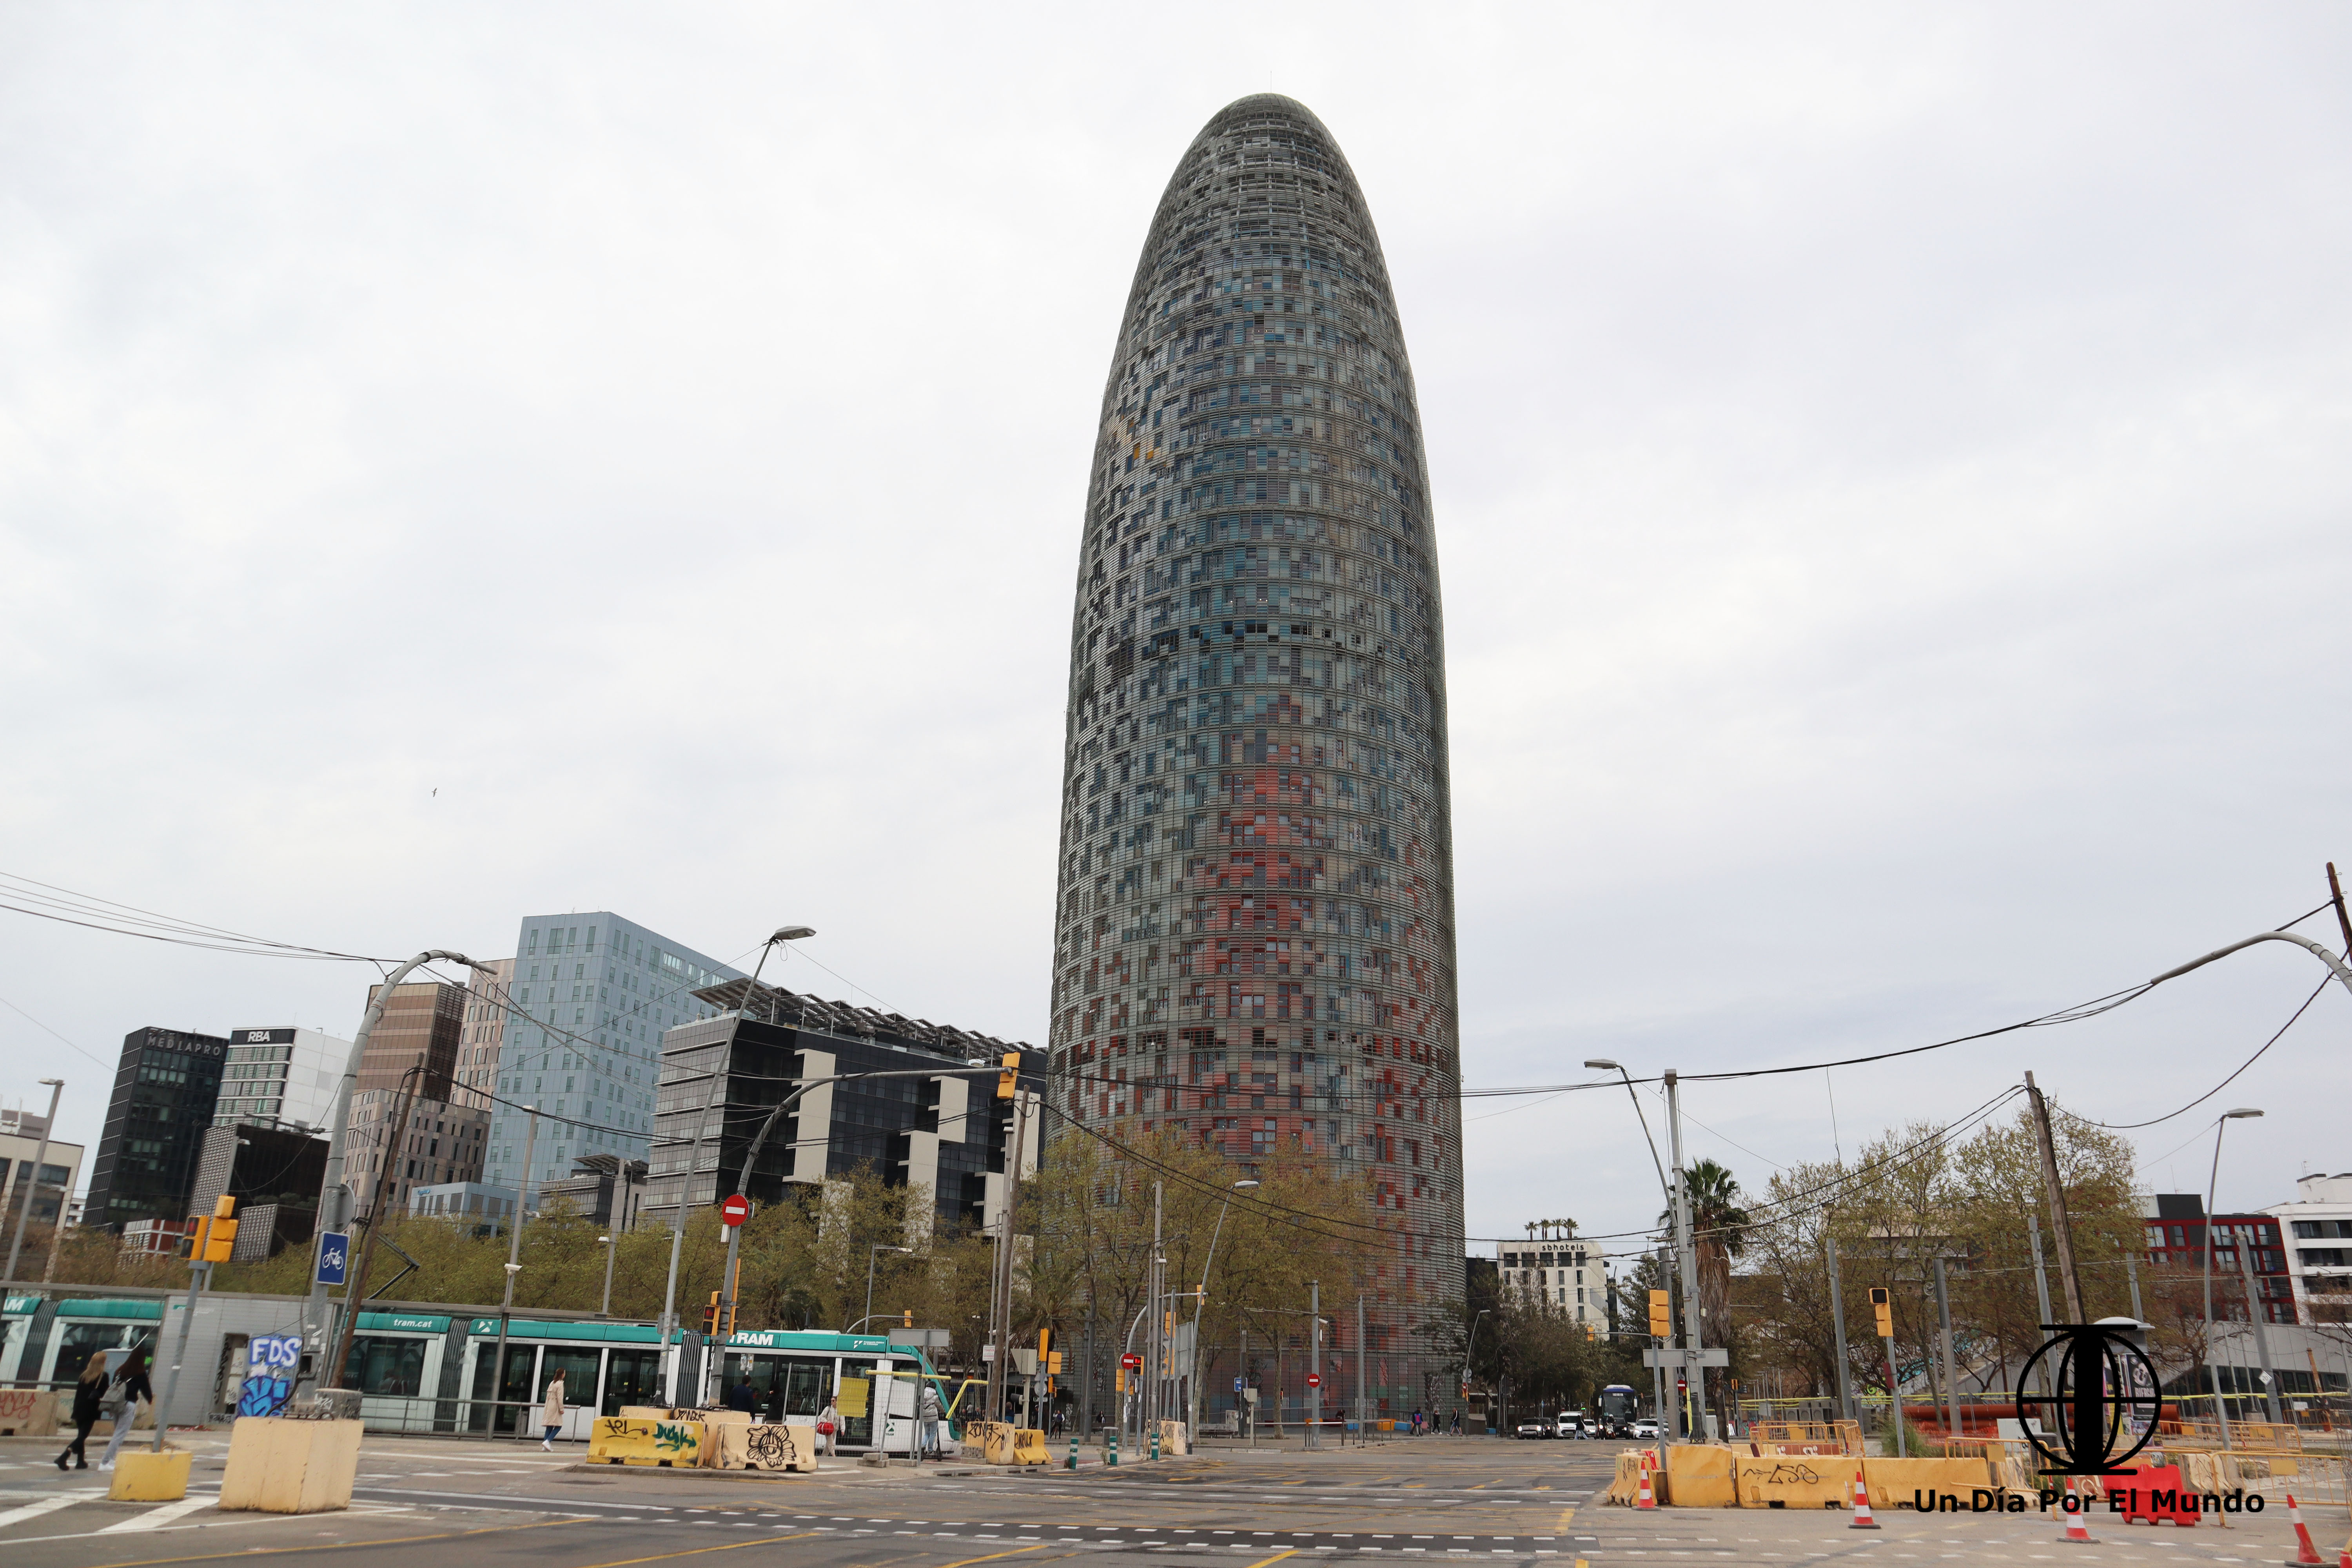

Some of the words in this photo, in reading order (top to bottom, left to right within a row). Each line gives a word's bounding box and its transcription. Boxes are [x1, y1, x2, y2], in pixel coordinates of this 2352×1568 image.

[247, 1031, 270, 1043] RBA
[147, 1036, 221, 1056] MEDIAPRO
[393, 1318, 432, 1328] tram.cat
[250, 1336, 303, 1368] FDS
